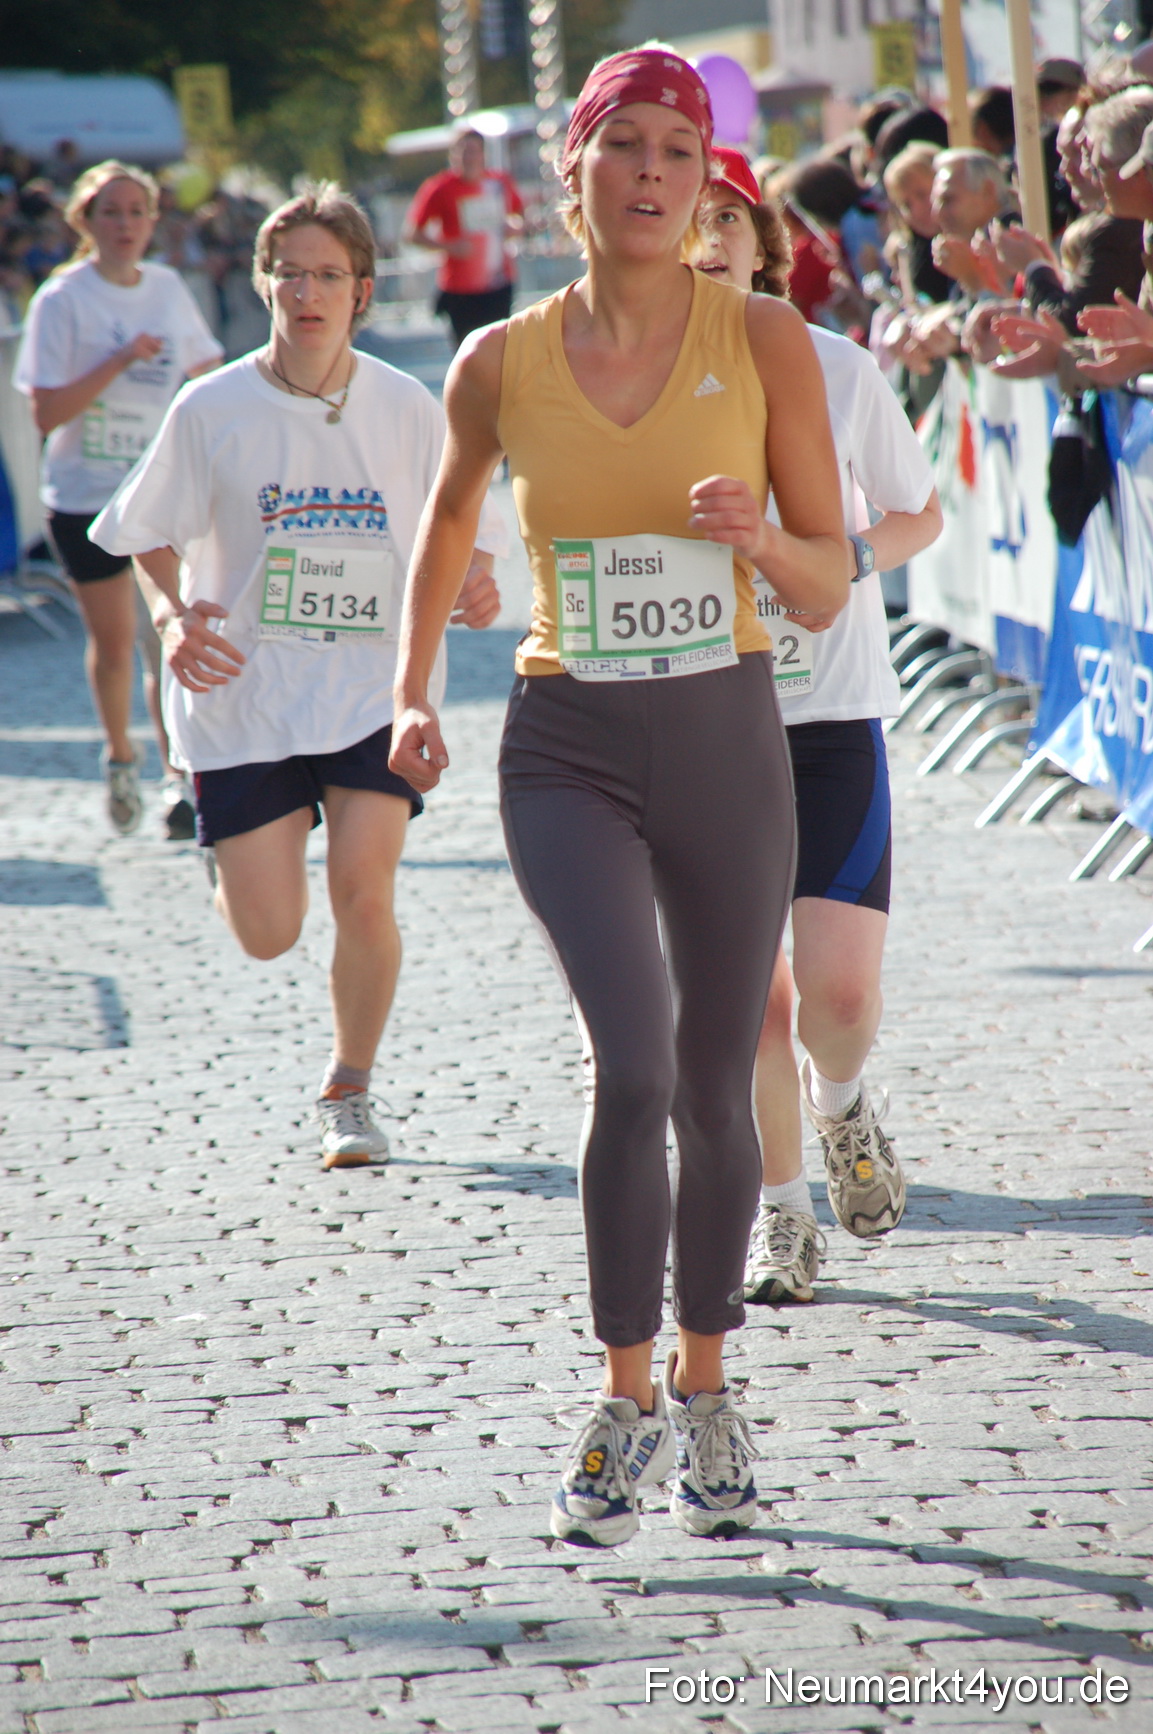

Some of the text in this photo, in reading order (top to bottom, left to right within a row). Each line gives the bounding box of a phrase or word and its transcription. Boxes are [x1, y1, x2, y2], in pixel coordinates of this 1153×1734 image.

[300, 557, 344, 577] David
[604, 549, 663, 576] Jessi
[267, 583, 283, 596] Sc
[300, 592, 378, 620] 5134
[565, 592, 585, 612] Sc
[611, 594, 722, 640] 5030
[671, 643, 733, 667] PFLEIDERER
[562, 659, 627, 674] BOCK
[585, 1451, 605, 1473] S
